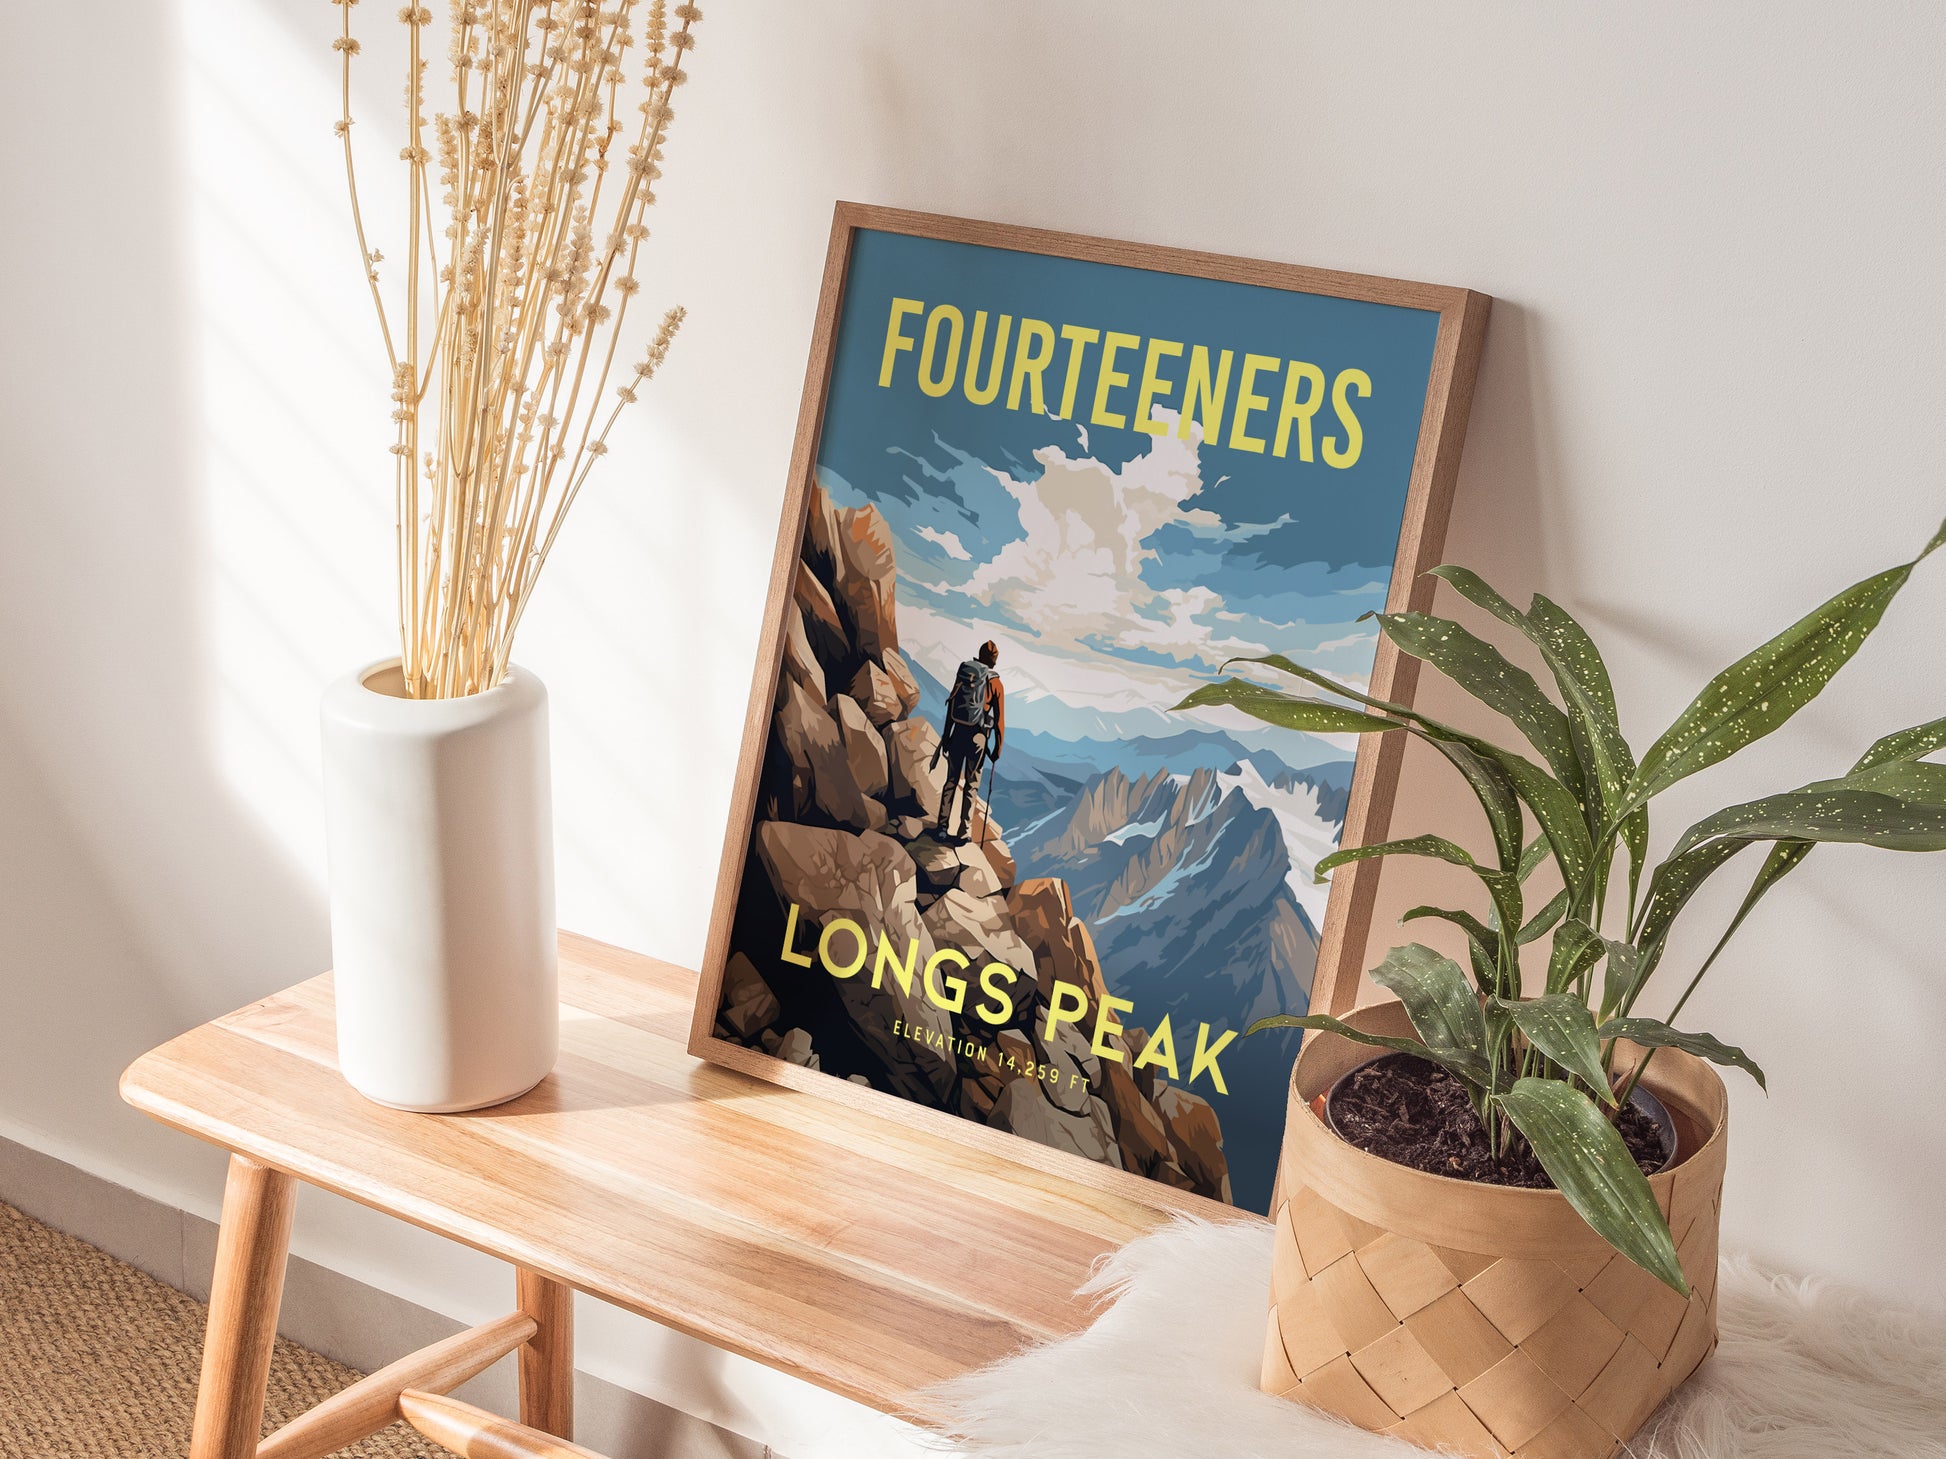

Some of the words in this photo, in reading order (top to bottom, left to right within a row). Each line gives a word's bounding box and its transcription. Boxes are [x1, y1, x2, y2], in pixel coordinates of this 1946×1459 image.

[878, 297, 1372, 470] FOURTEENERS
[780, 903, 1018, 1026] LONGS
[1043, 980, 1239, 1096] PEAK
[893, 1020, 987, 1062] ELEVATION
[998, 1052, 1060, 1084] 14,259
[1069, 1074, 1091, 1093] FT
